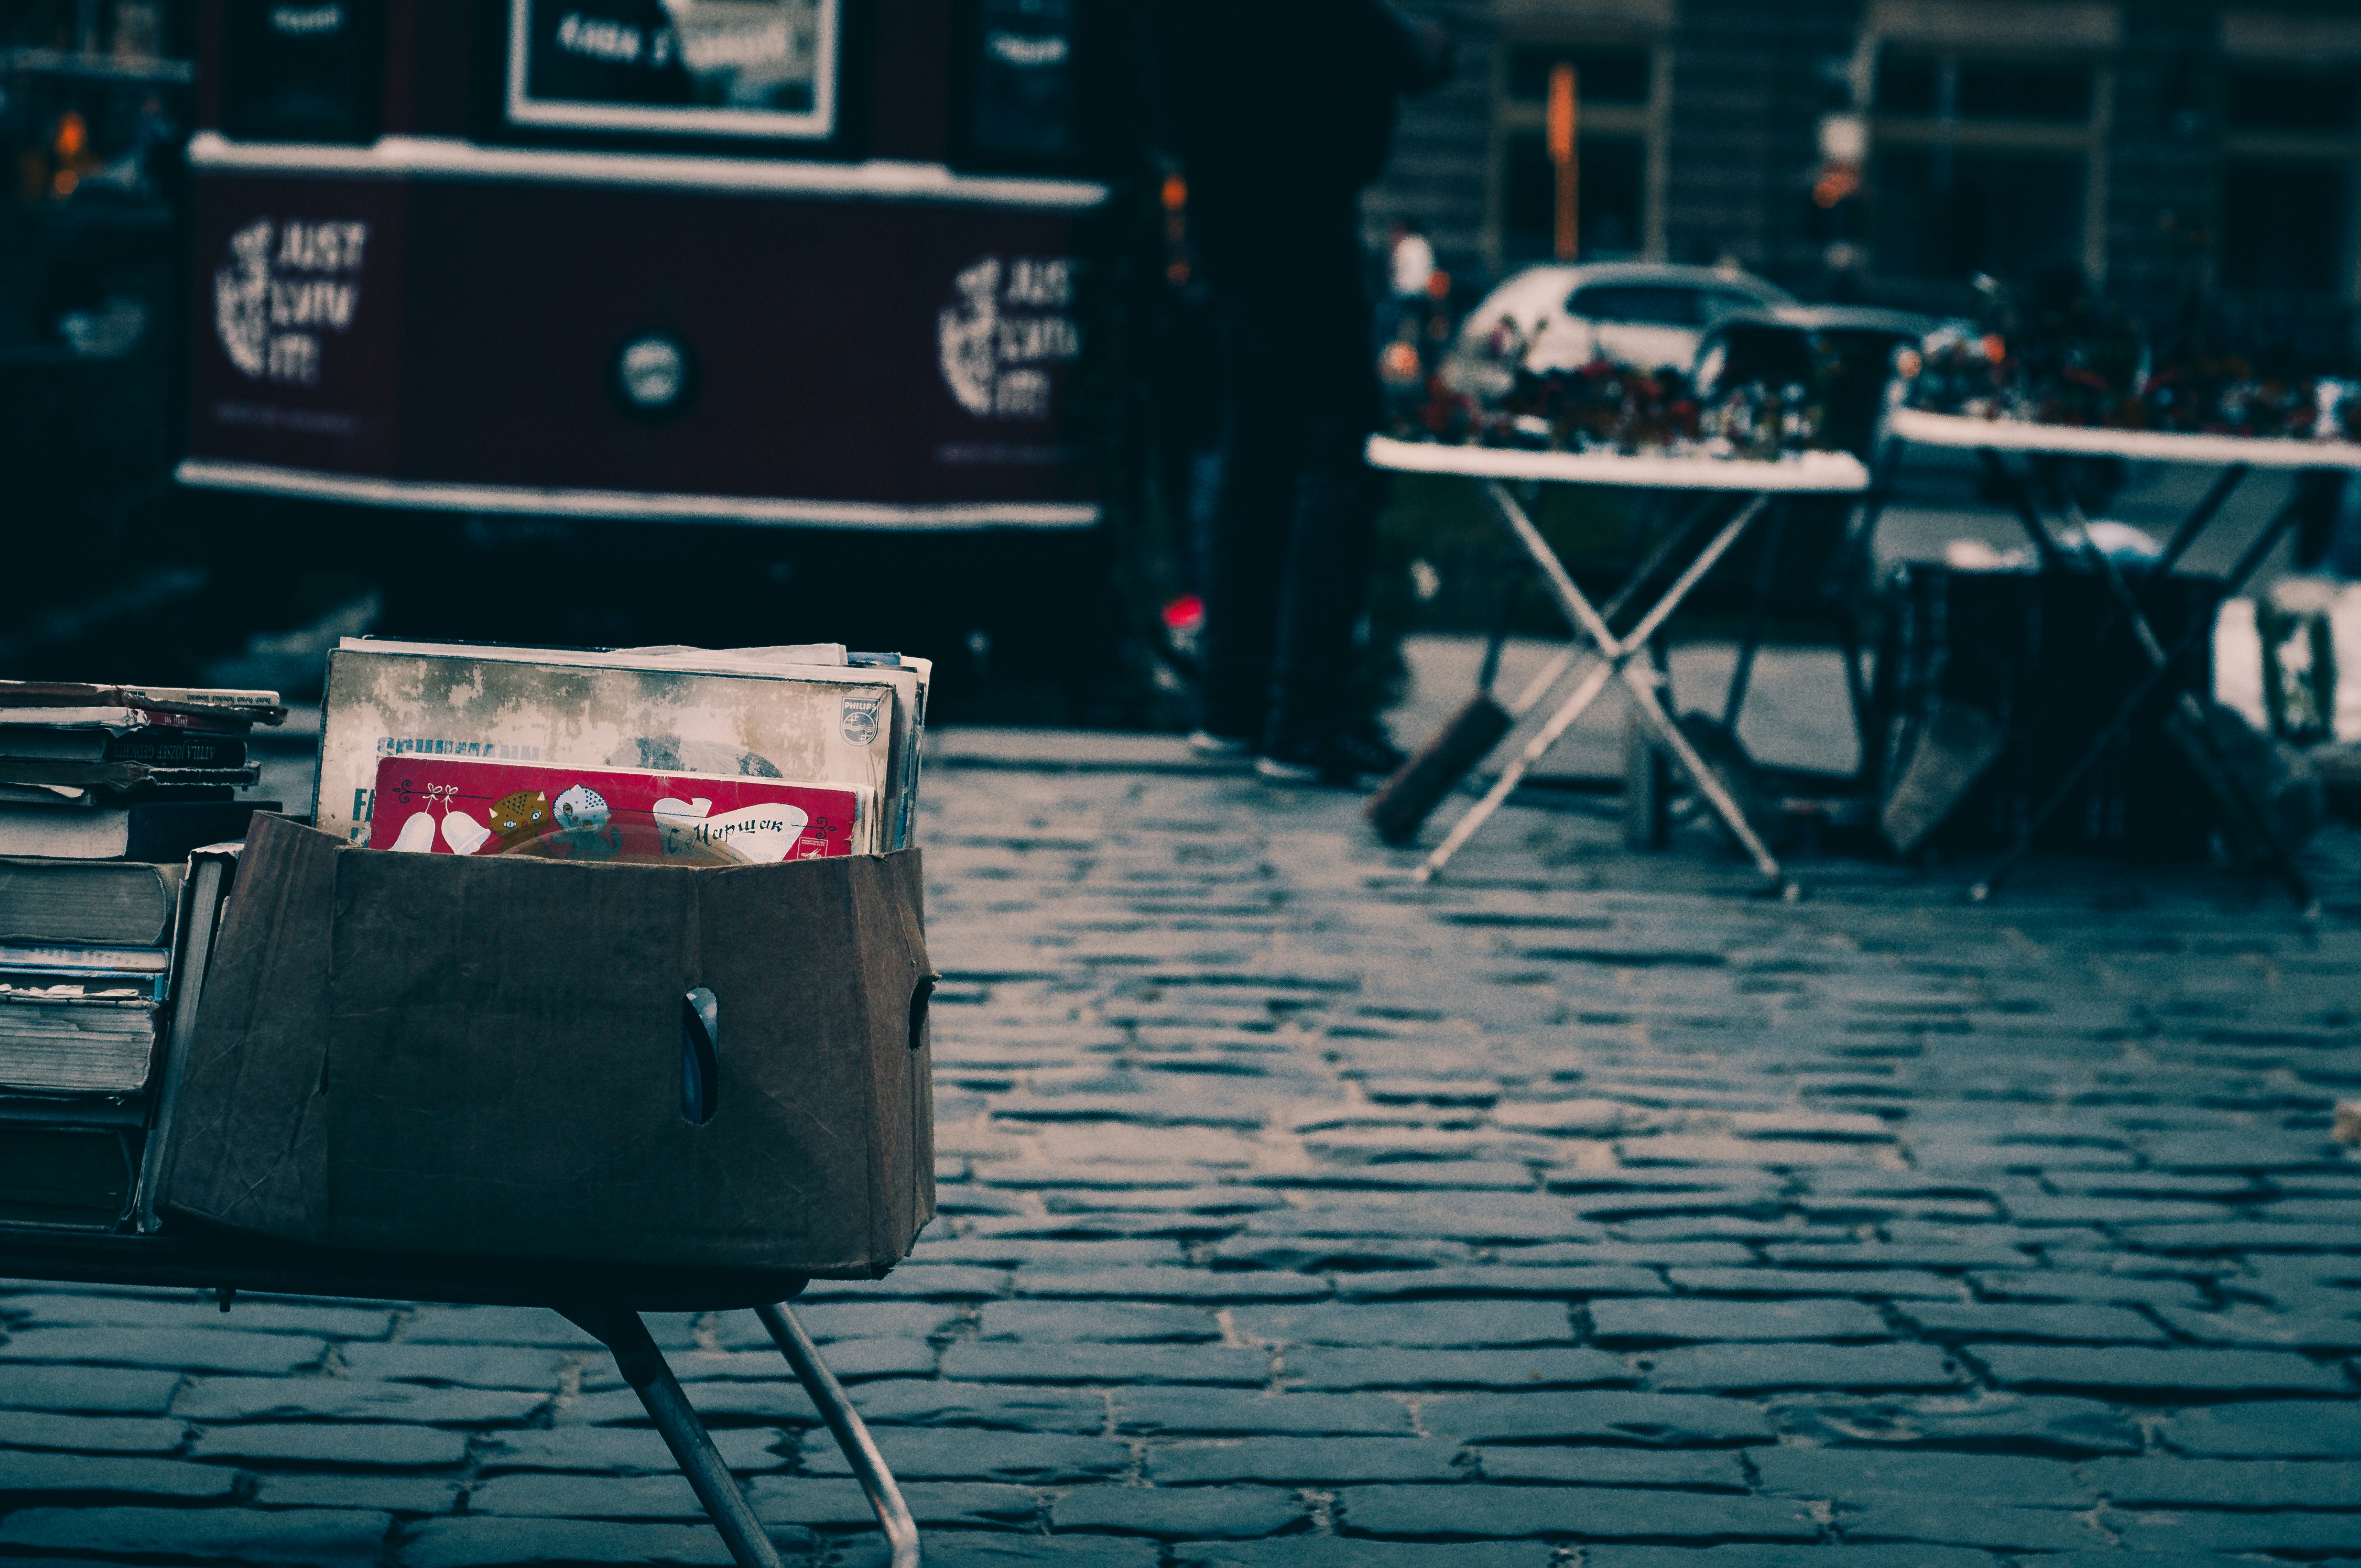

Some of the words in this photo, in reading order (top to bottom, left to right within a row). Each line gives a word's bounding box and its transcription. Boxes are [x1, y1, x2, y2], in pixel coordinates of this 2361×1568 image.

[844, 701, 877, 711] PHILIPS
[113, 744, 154, 759] GEDICHTE
[187, 745, 215, 760] ATTILA
[686, 819, 783, 851] Маршак
